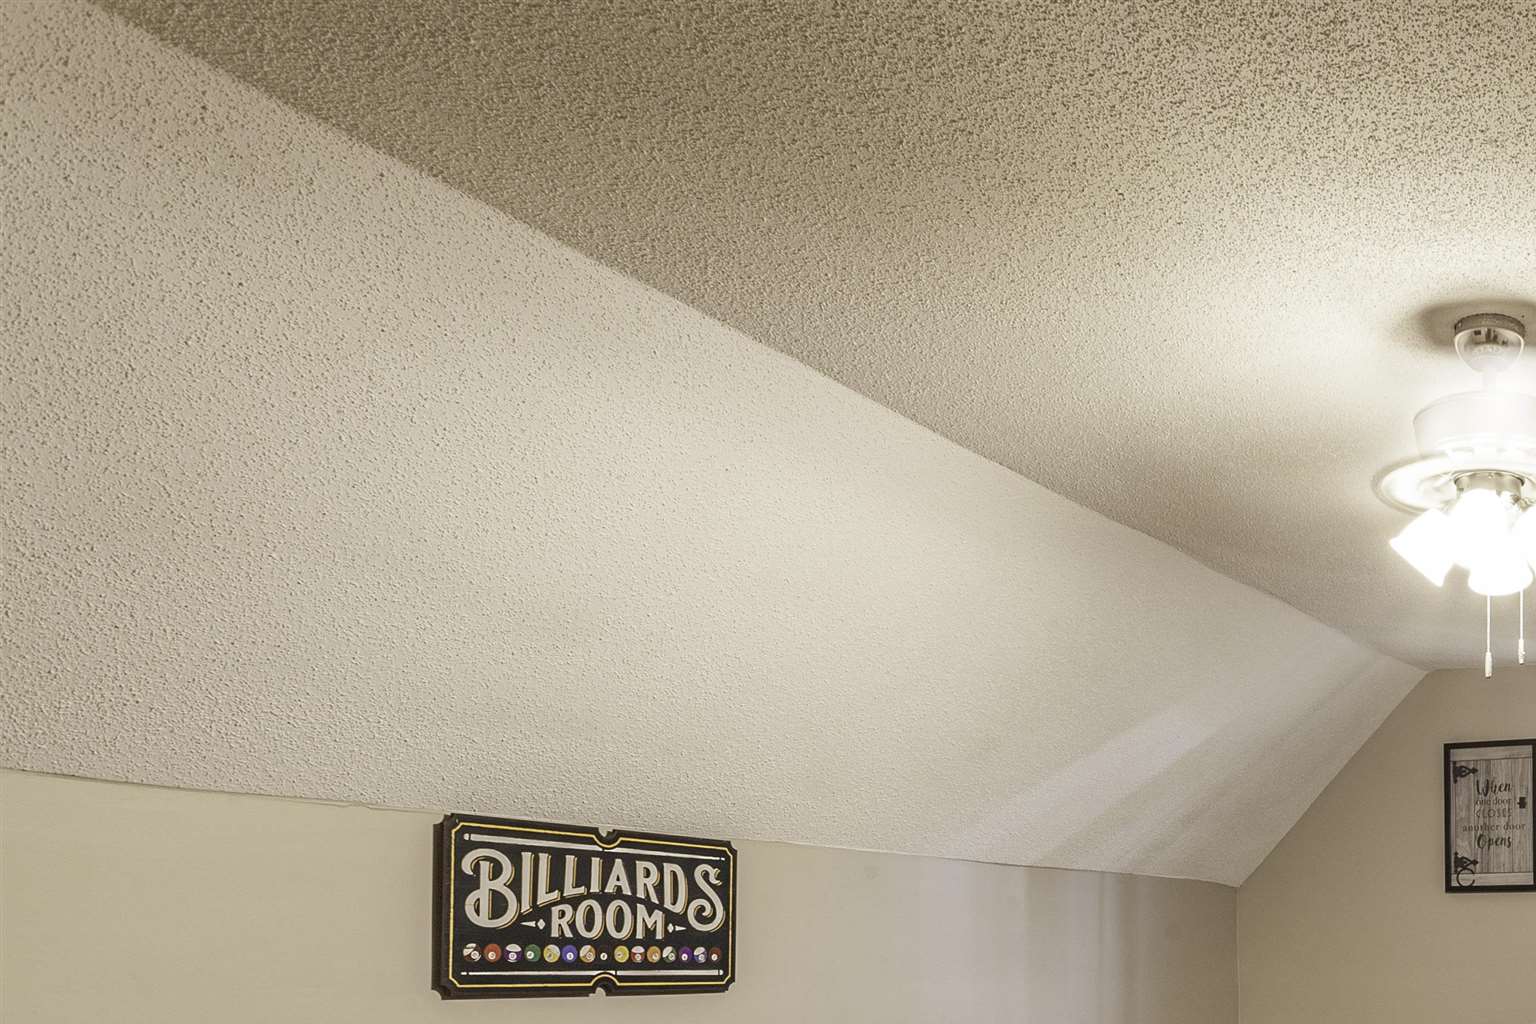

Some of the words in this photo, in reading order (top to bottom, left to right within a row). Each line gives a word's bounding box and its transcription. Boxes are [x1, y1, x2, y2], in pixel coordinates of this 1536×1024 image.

[1476, 779, 1511, 797] When
[1503, 821, 1526, 832] door
[1477, 834, 1512, 851] Opens
[461, 848, 726, 932] BILLIARDS
[551, 899, 664, 939] ROOM
